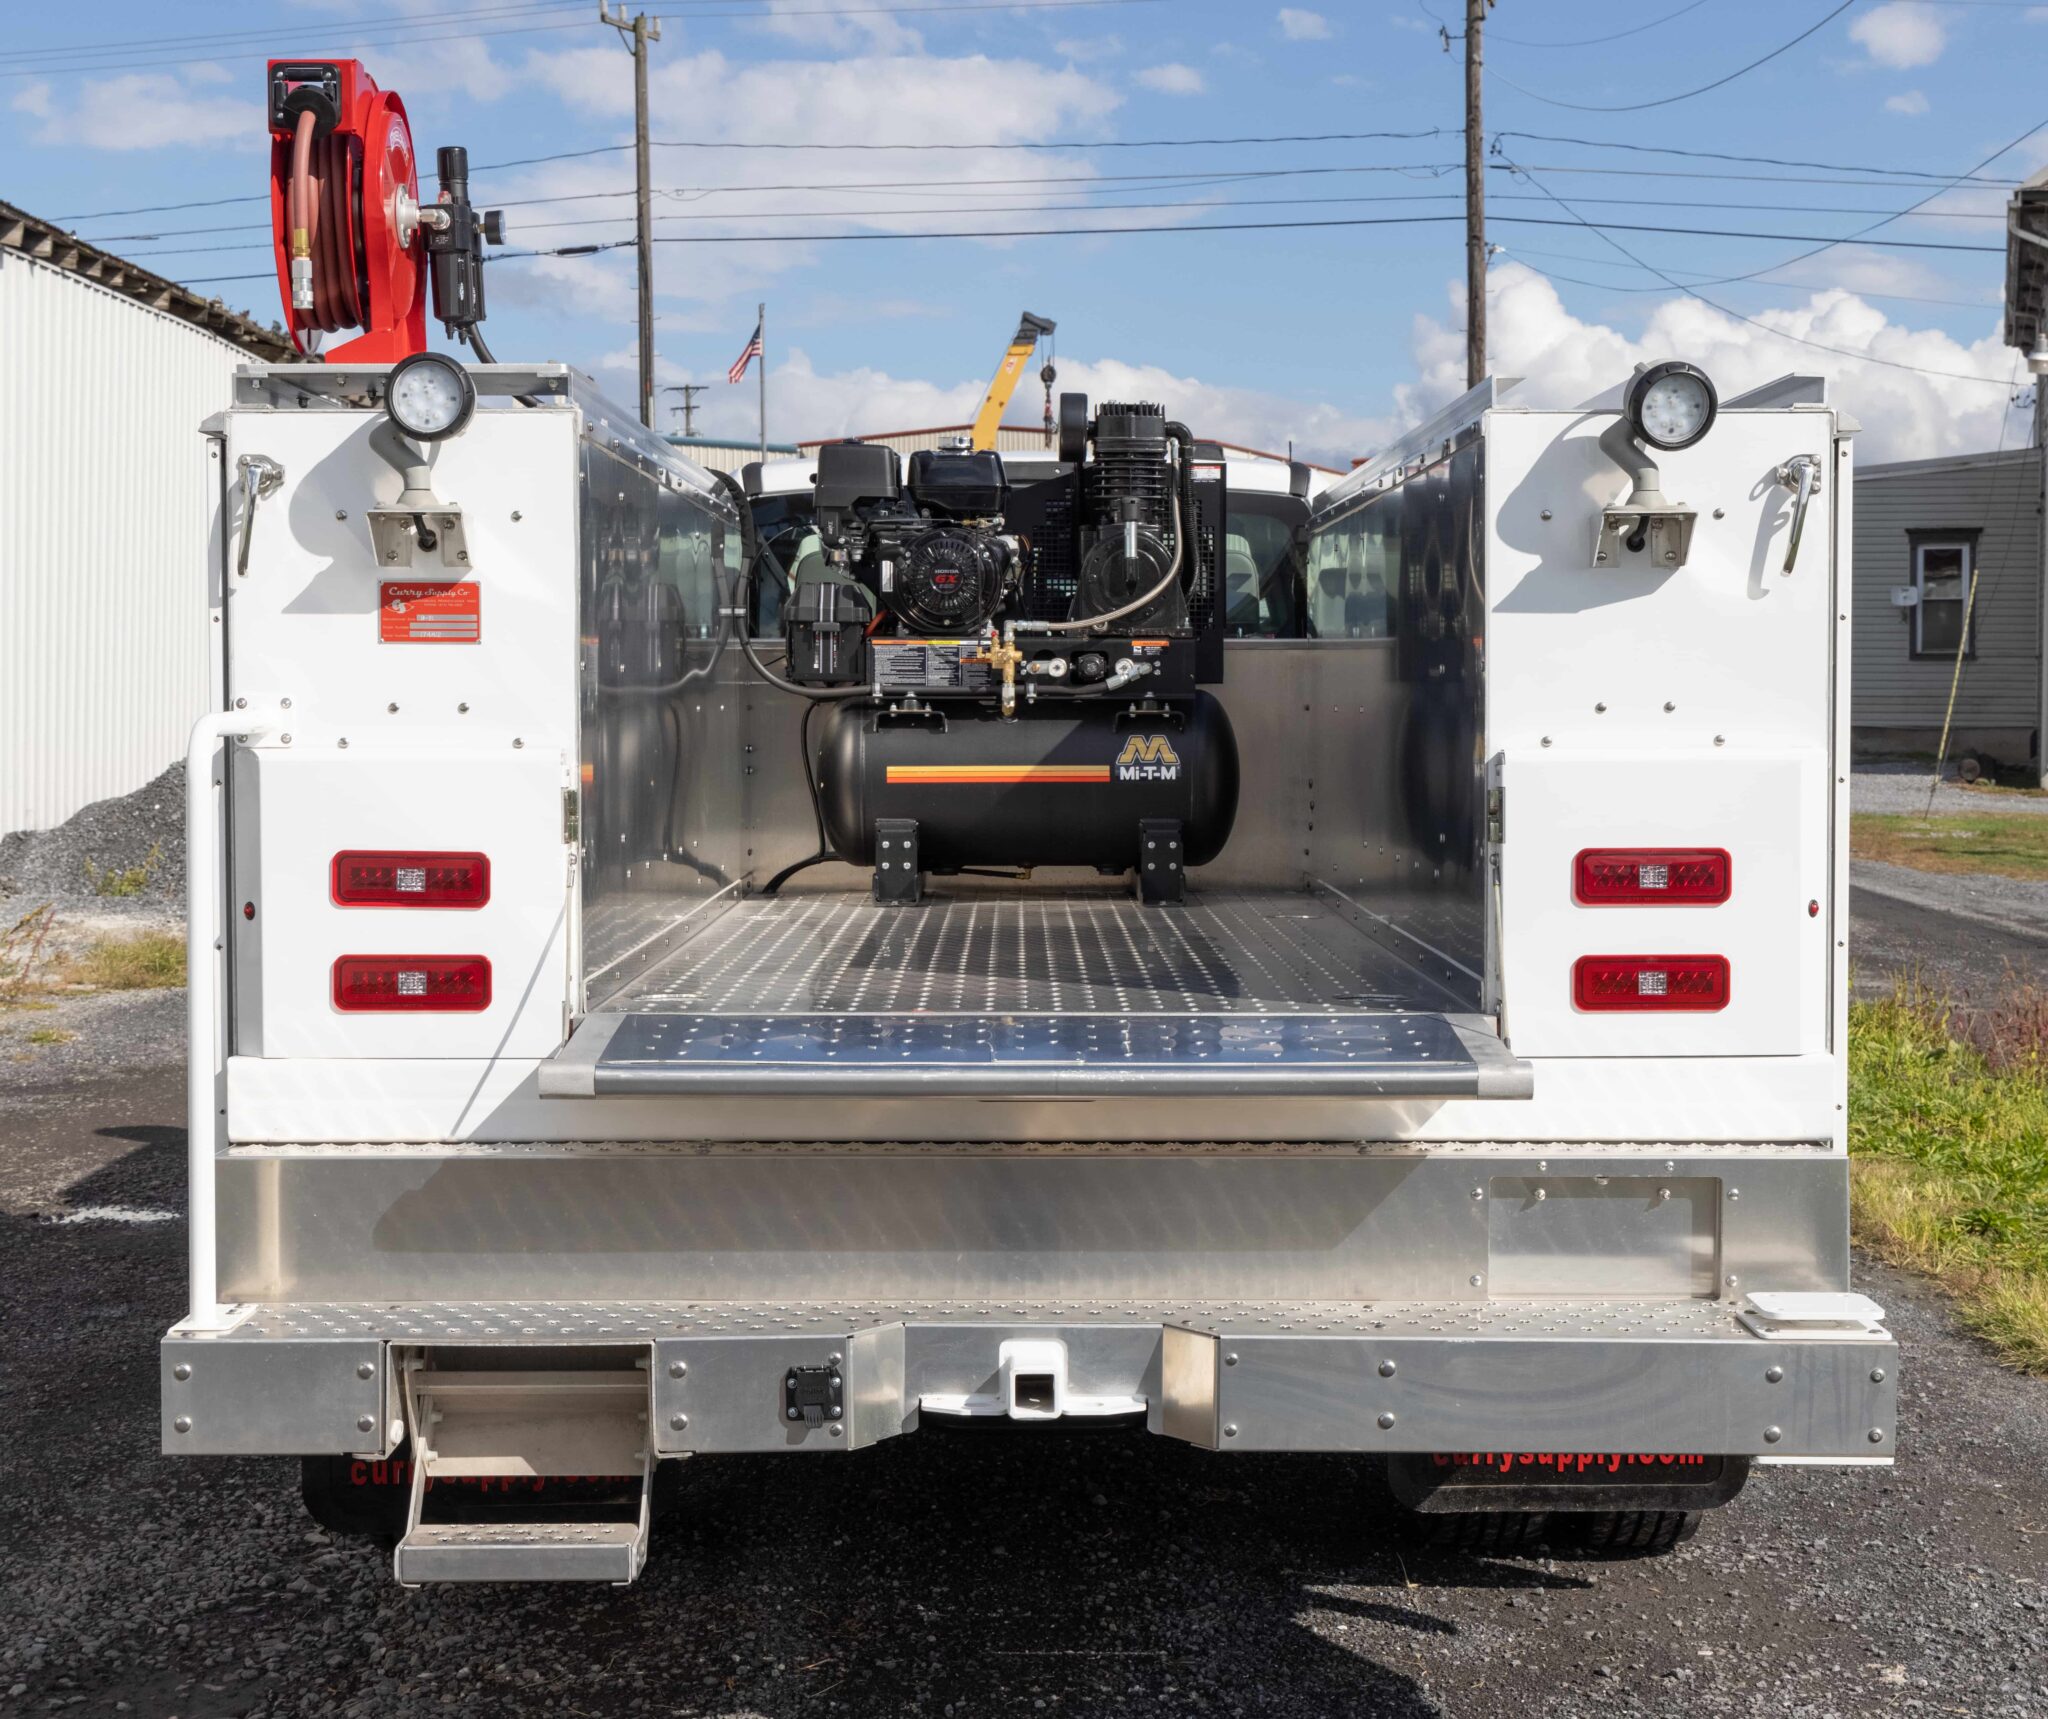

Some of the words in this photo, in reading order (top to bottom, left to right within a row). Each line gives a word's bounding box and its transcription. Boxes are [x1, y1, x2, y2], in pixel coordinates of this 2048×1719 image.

[934, 575, 957, 584] GX
[388, 586, 422, 598] Curry
[424, 588, 456, 597] Supply
[1120, 766, 1176, 780] Mi-T-M
